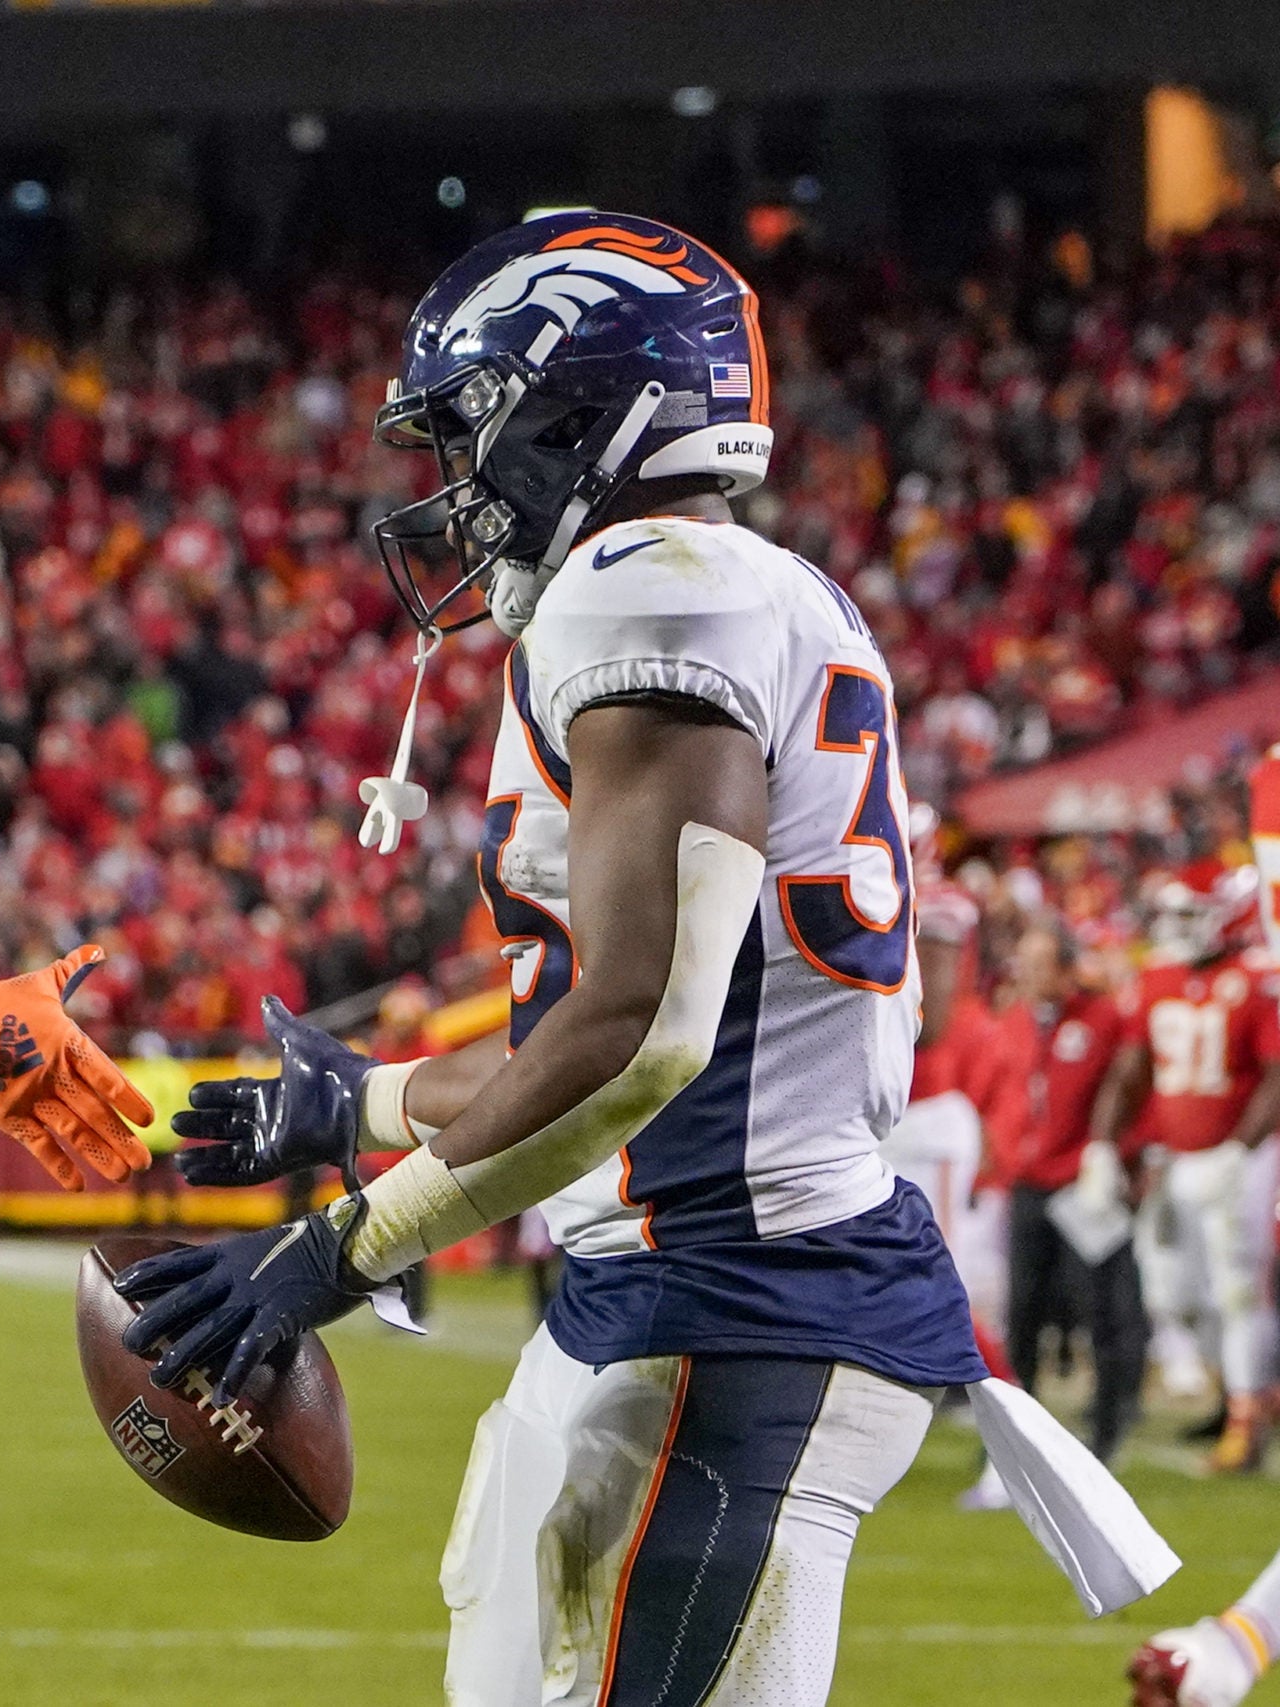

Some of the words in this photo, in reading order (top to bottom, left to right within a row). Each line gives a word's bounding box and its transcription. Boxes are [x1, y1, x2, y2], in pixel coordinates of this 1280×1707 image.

[717, 441, 754, 456] BLACK
[1147, 998, 1231, 1096] 91
[117, 1421, 158, 1473] NFL
